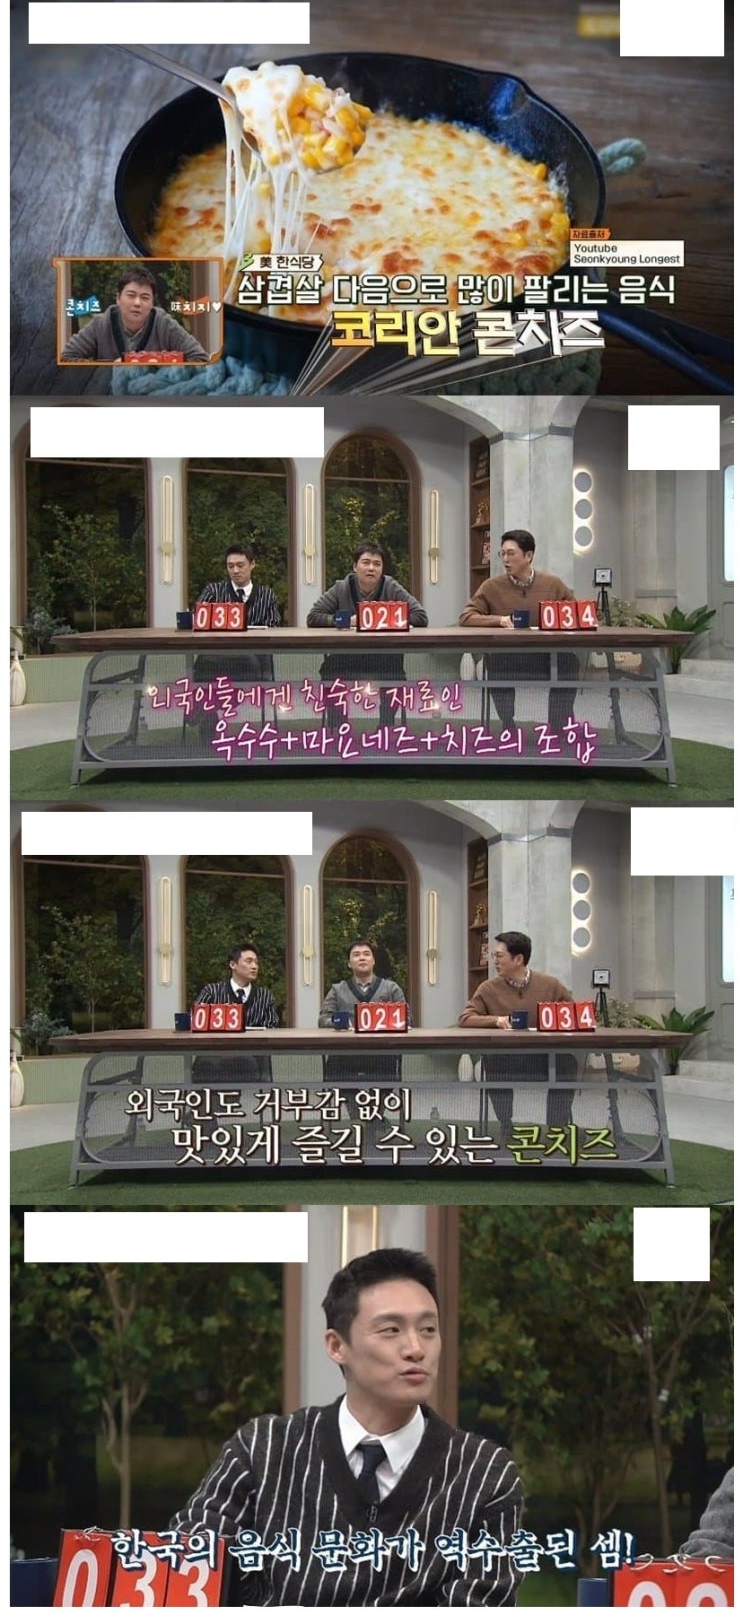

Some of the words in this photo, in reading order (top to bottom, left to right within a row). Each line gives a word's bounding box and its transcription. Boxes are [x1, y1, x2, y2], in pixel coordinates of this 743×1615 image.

[197, 607, 241, 629] 033
[362, 607, 407, 629] 021
[542, 606, 594, 627] 034
[195, 1009, 238, 1029] 033
[360, 1009, 405, 1030] 021
[542, 1006, 593, 1027] 034
